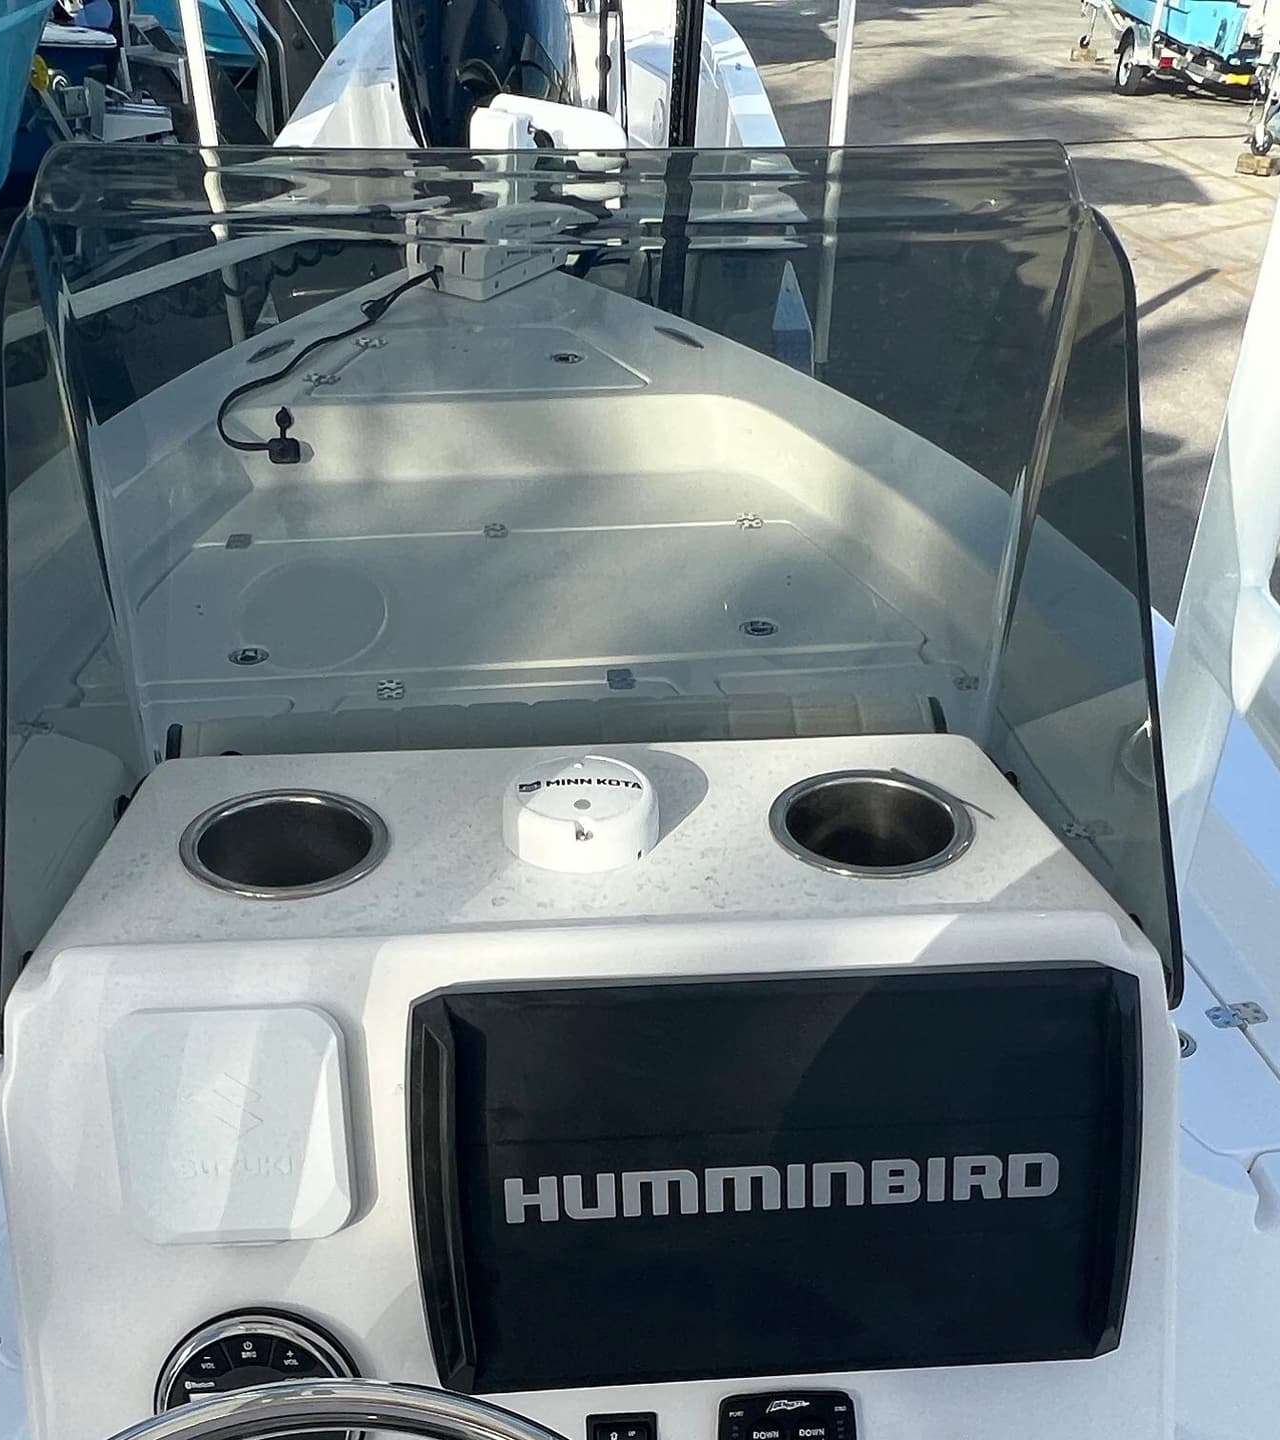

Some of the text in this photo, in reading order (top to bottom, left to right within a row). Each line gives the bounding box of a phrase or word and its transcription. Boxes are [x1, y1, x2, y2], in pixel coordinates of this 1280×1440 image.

[546, 778, 642, 790] MINN KOTA
[504, 1151, 1060, 1225] HUMMINBIRD
[201, 1362, 216, 1370] VOL
[283, 1358, 299, 1366] VOL
[753, 1430, 779, 1440] DOWN
[799, 1427, 825, 1437] DOWN
